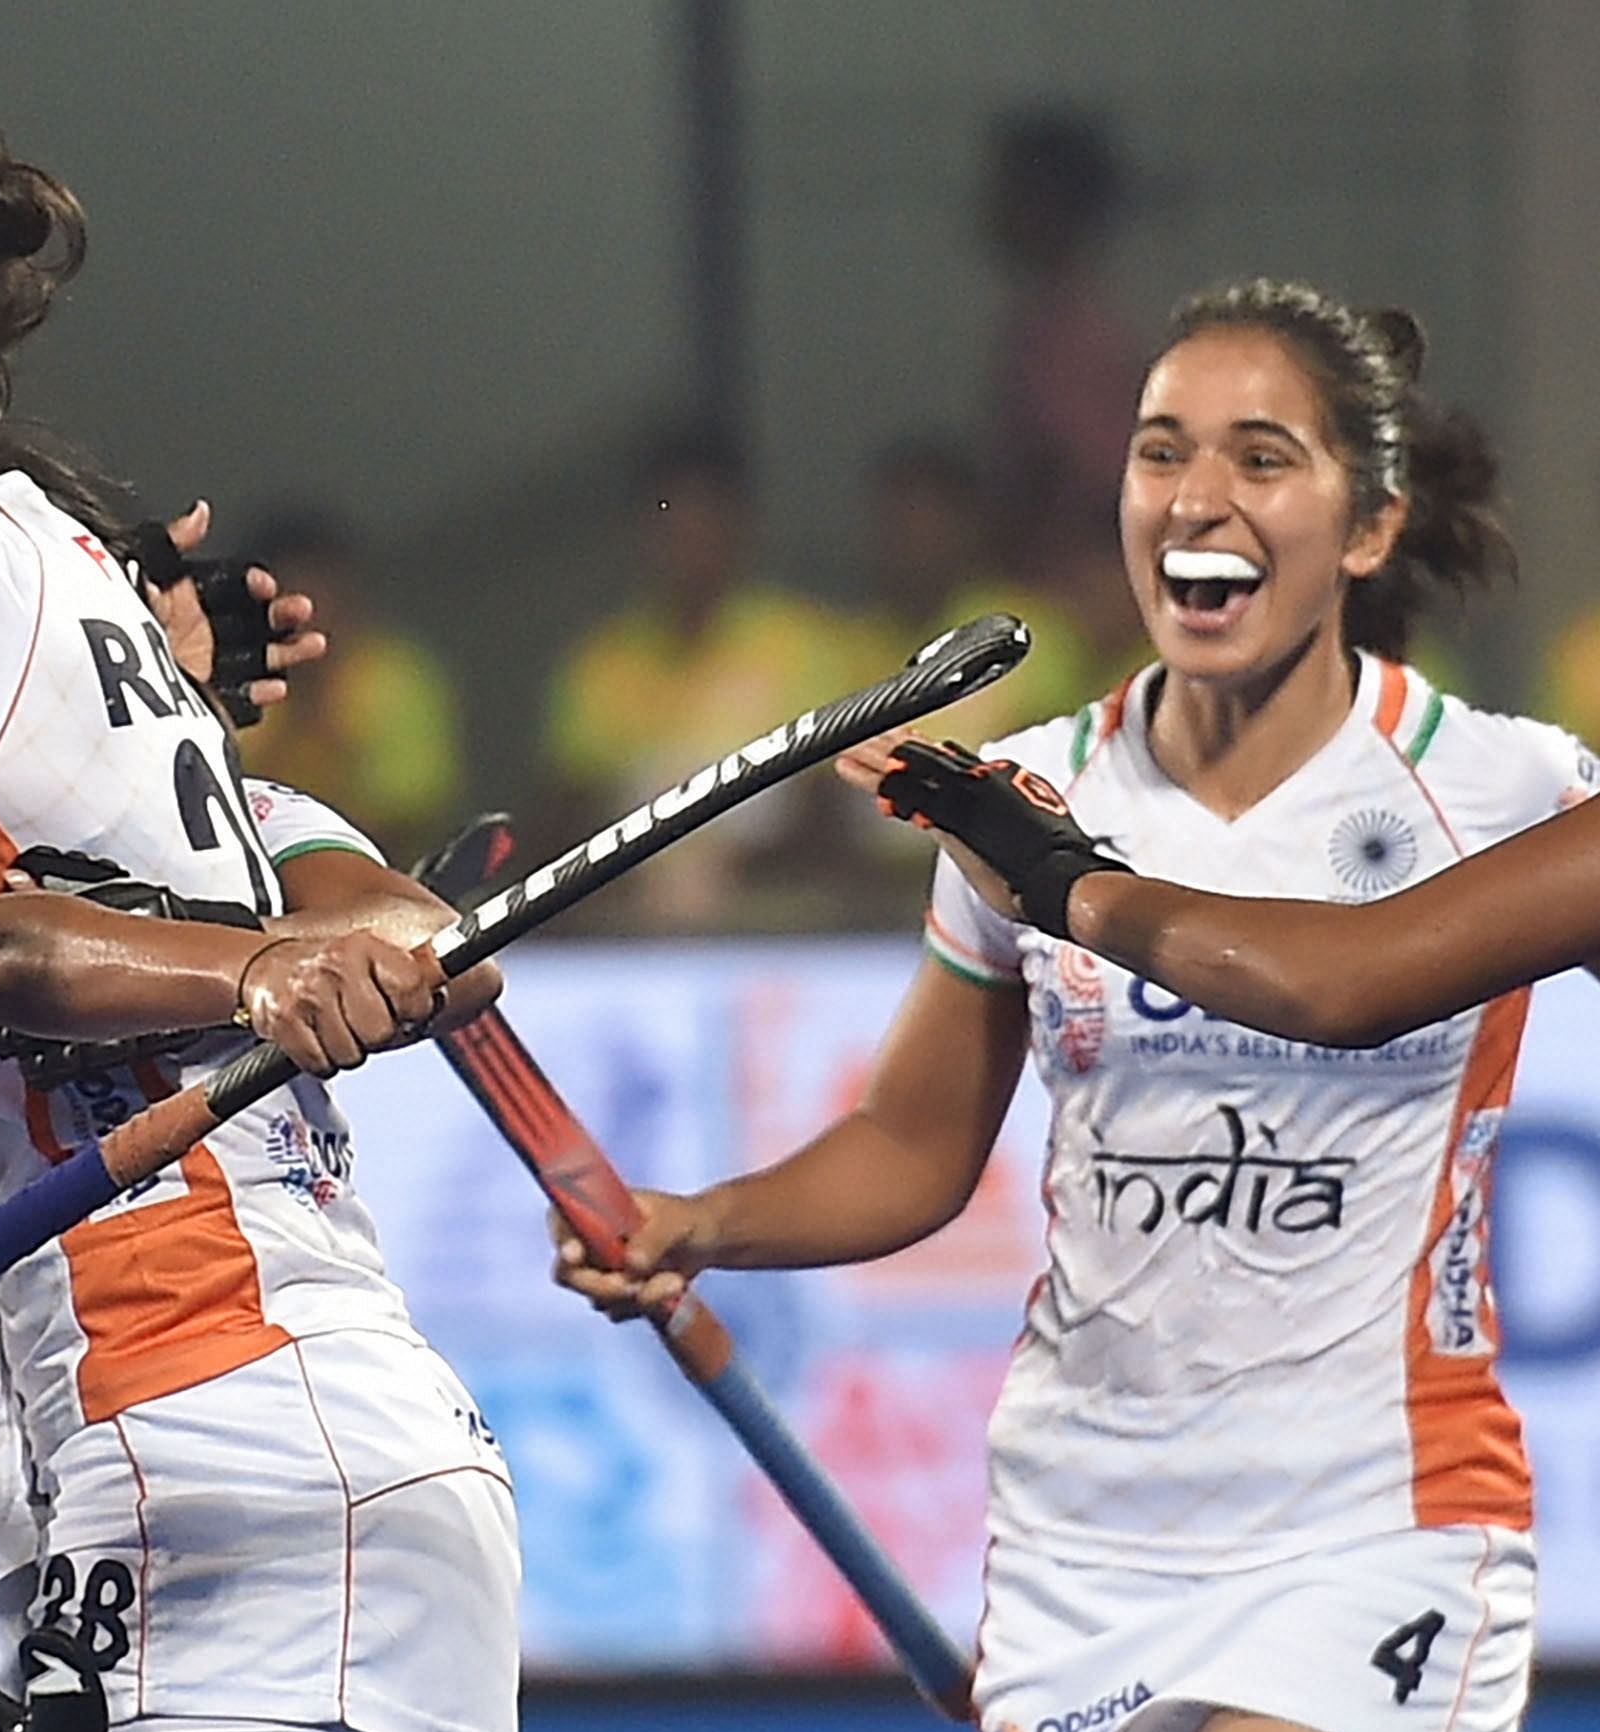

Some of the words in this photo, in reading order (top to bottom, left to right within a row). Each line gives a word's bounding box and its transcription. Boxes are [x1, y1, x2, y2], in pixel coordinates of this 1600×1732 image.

[1236, 1035, 1295, 1059] BEST
[1091, 1103, 1357, 1234] india
[41, 1553, 136, 1672] 28
[1370, 1607, 1447, 1706] 4
